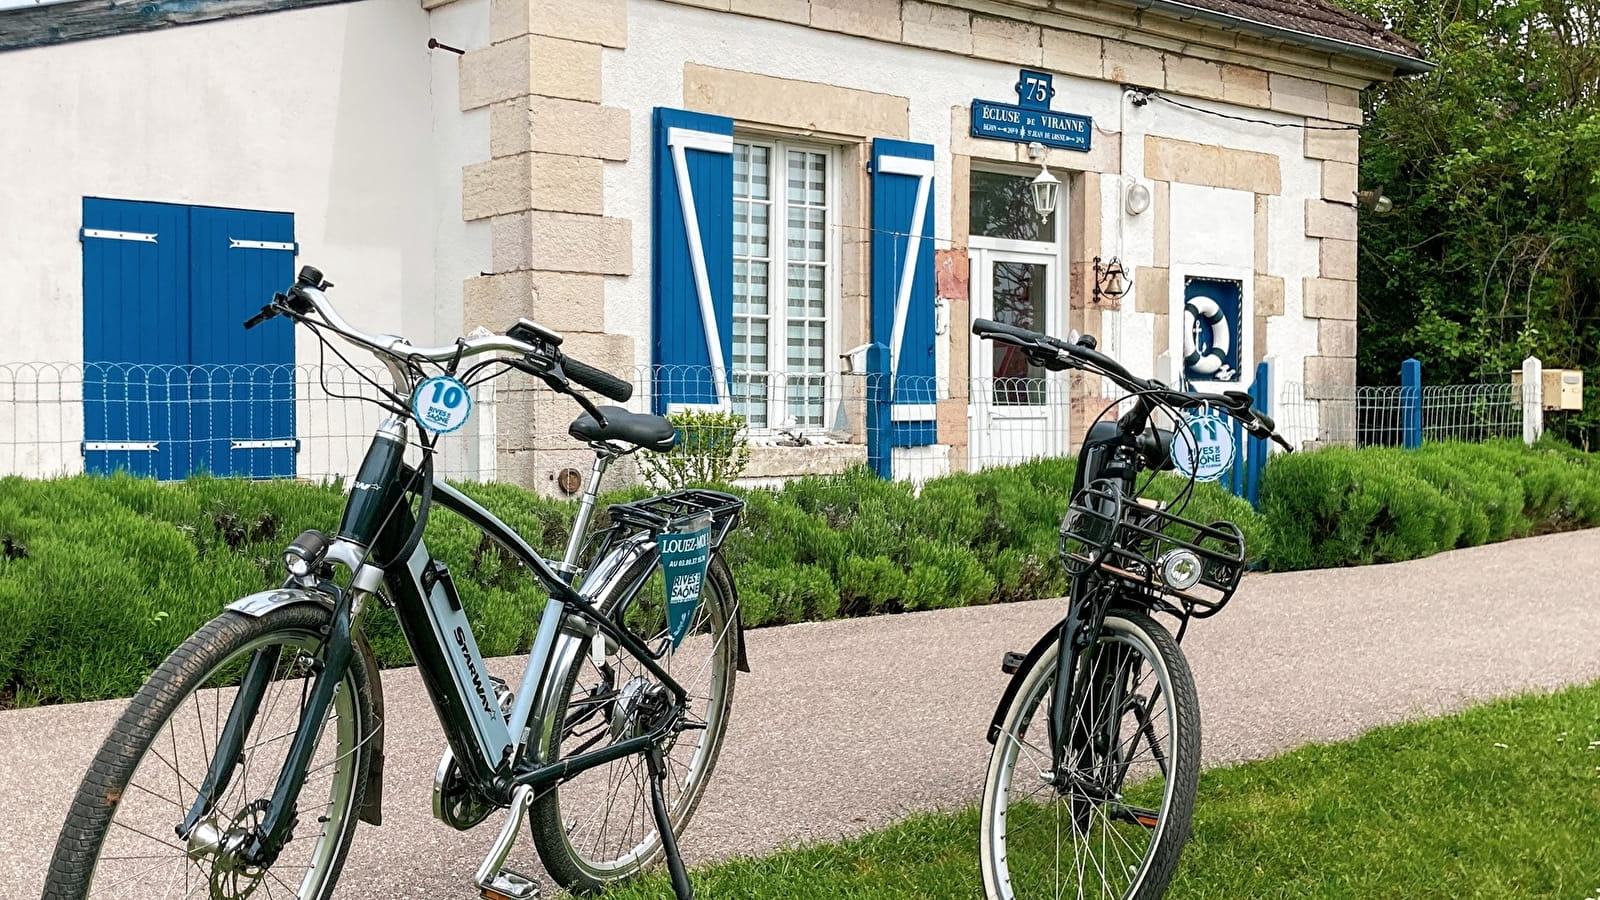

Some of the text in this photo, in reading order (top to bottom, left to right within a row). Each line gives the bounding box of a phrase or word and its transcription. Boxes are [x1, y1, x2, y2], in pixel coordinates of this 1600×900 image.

[1026, 78, 1047, 101] 75
[982, 105, 1084, 132] ÉCLUSE DE VIRANNE
[1032, 130, 1044, 138] JEAN
[1051, 133, 1067, 142] LOSNE
[432, 382, 462, 408] 10
[1190, 421, 1217, 442] 11
[672, 584, 699, 598] SAÔNE
[673, 574, 696, 586] RIVES
[454, 626, 491, 712] STARWAY
